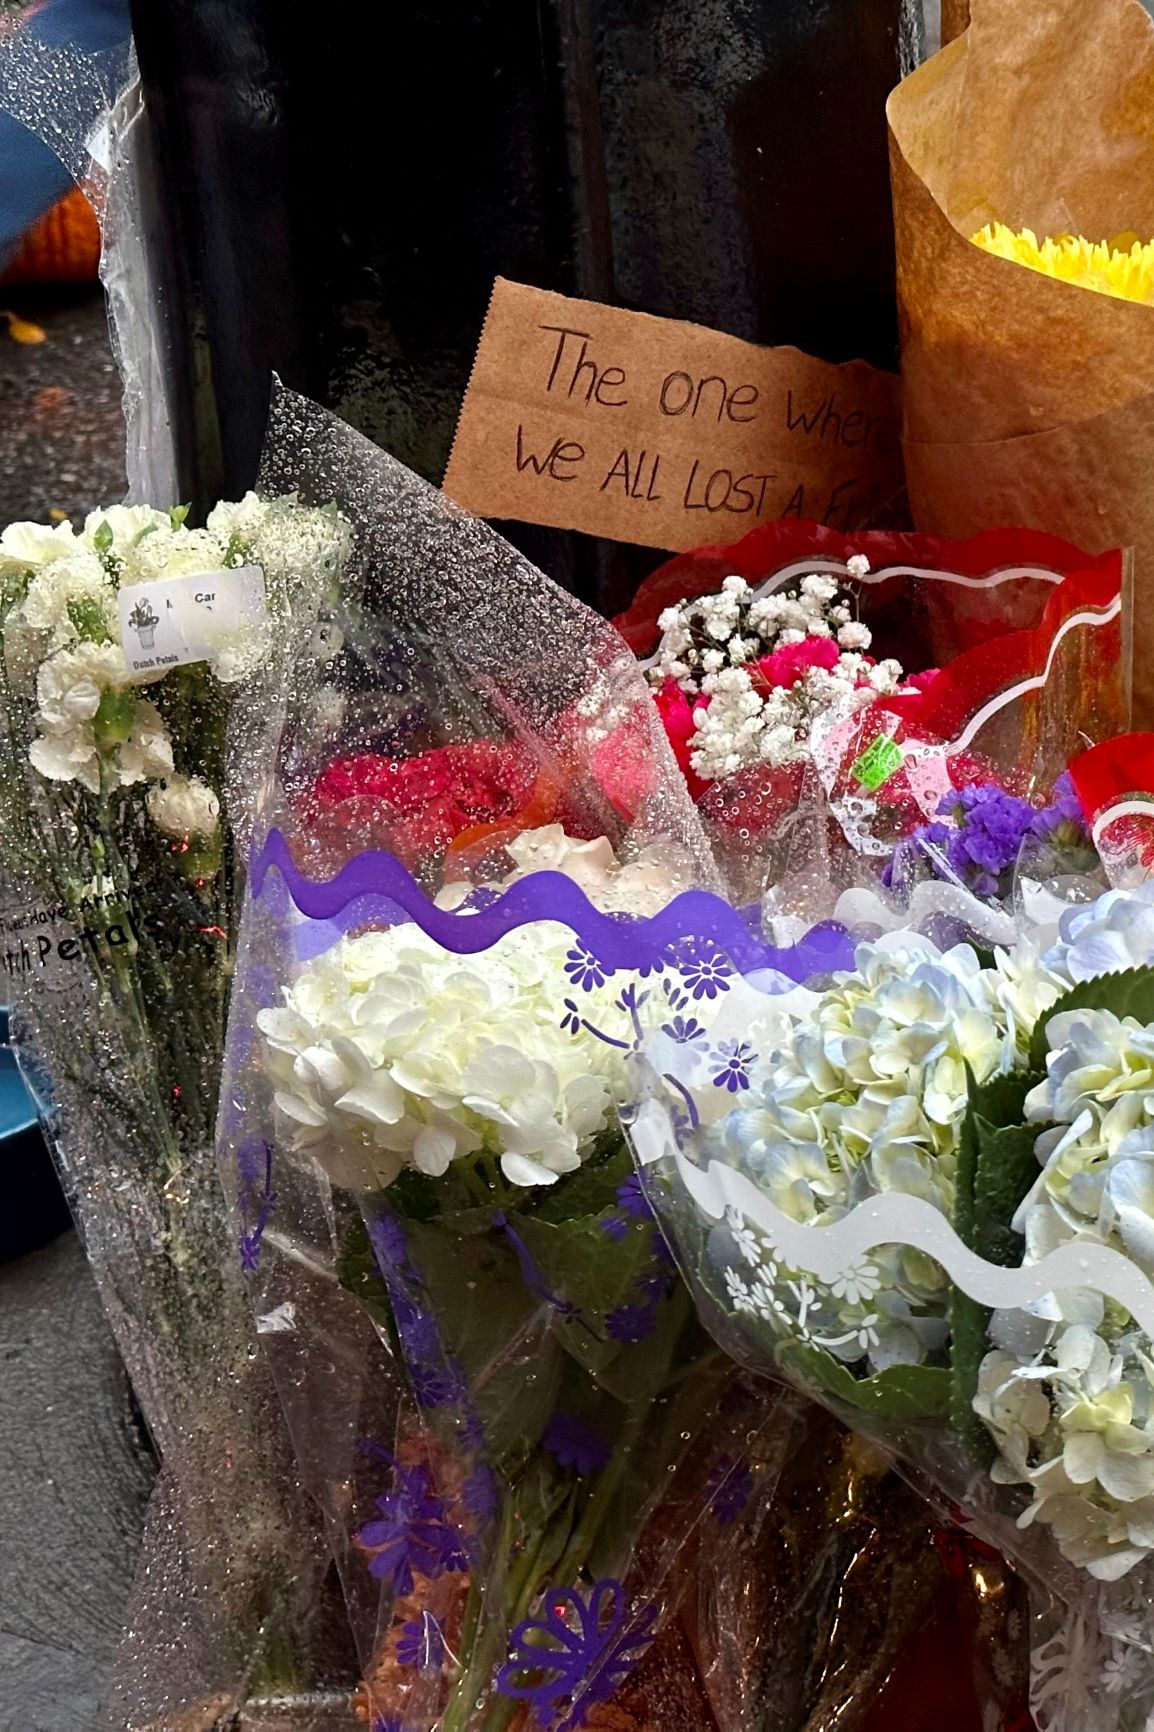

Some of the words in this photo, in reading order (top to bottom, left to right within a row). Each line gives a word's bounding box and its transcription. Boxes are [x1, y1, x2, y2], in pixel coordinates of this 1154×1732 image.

[539, 325, 627, 407] The
[659, 370, 759, 424] one
[600, 448, 661, 502] ALL
[684, 459, 776, 516] LOST
[782, 484, 804, 518] A
[133, 660, 155, 671] Dutch
[156, 654, 180, 666] Petals
